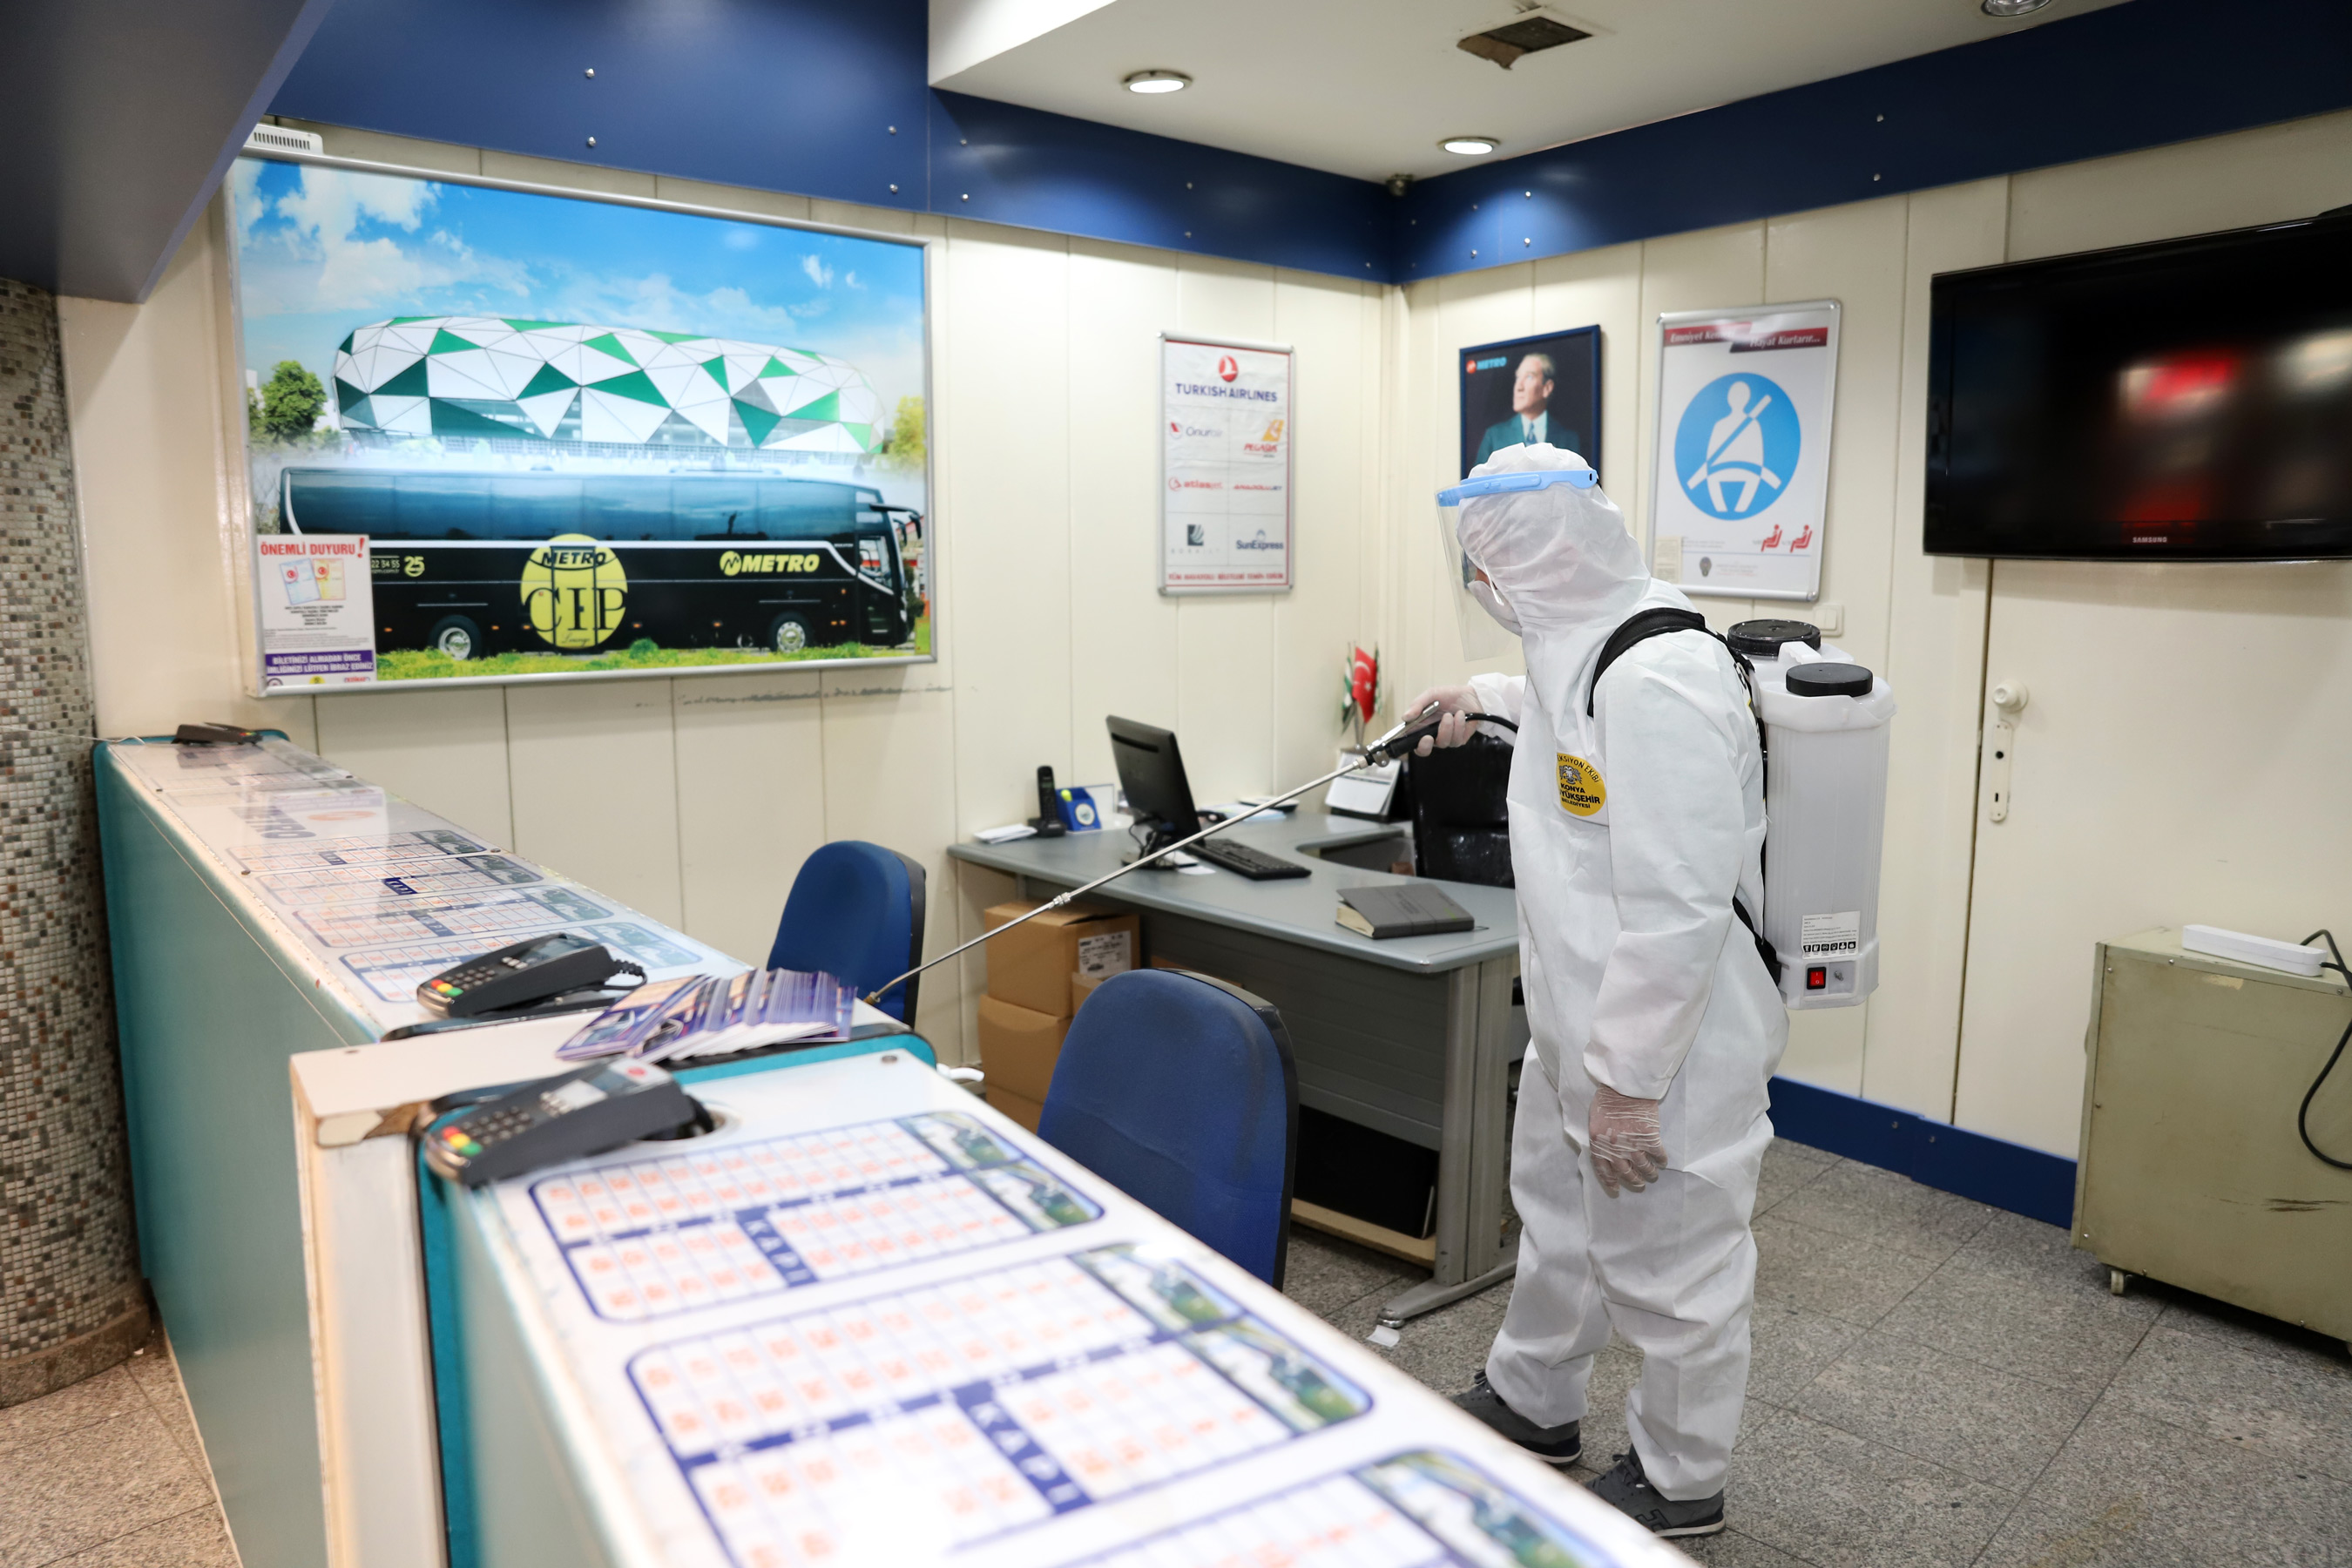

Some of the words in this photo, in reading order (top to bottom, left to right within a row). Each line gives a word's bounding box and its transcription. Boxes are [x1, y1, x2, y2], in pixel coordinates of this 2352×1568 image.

[1670, 331, 1704, 343] Emniyet
[1750, 336, 1776, 348] Hayat
[1476, 356, 1507, 370] METRO
[1175, 382, 1227, 397] TURKISH
[1228, 388, 1278, 402] AIRLINES
[260, 541, 306, 556] ÖNEMLİ
[1236, 539, 1284, 551] SunExpress
[541, 551, 606, 566] METRO
[740, 553, 820, 573] METRO
[343, 652, 362, 662] ÖNCE
[1584, 765, 1600, 783] EKİBİ
[1560, 783, 1585, 794] KONYA
[1562, 797, 1591, 808] BELEDİYESİ
